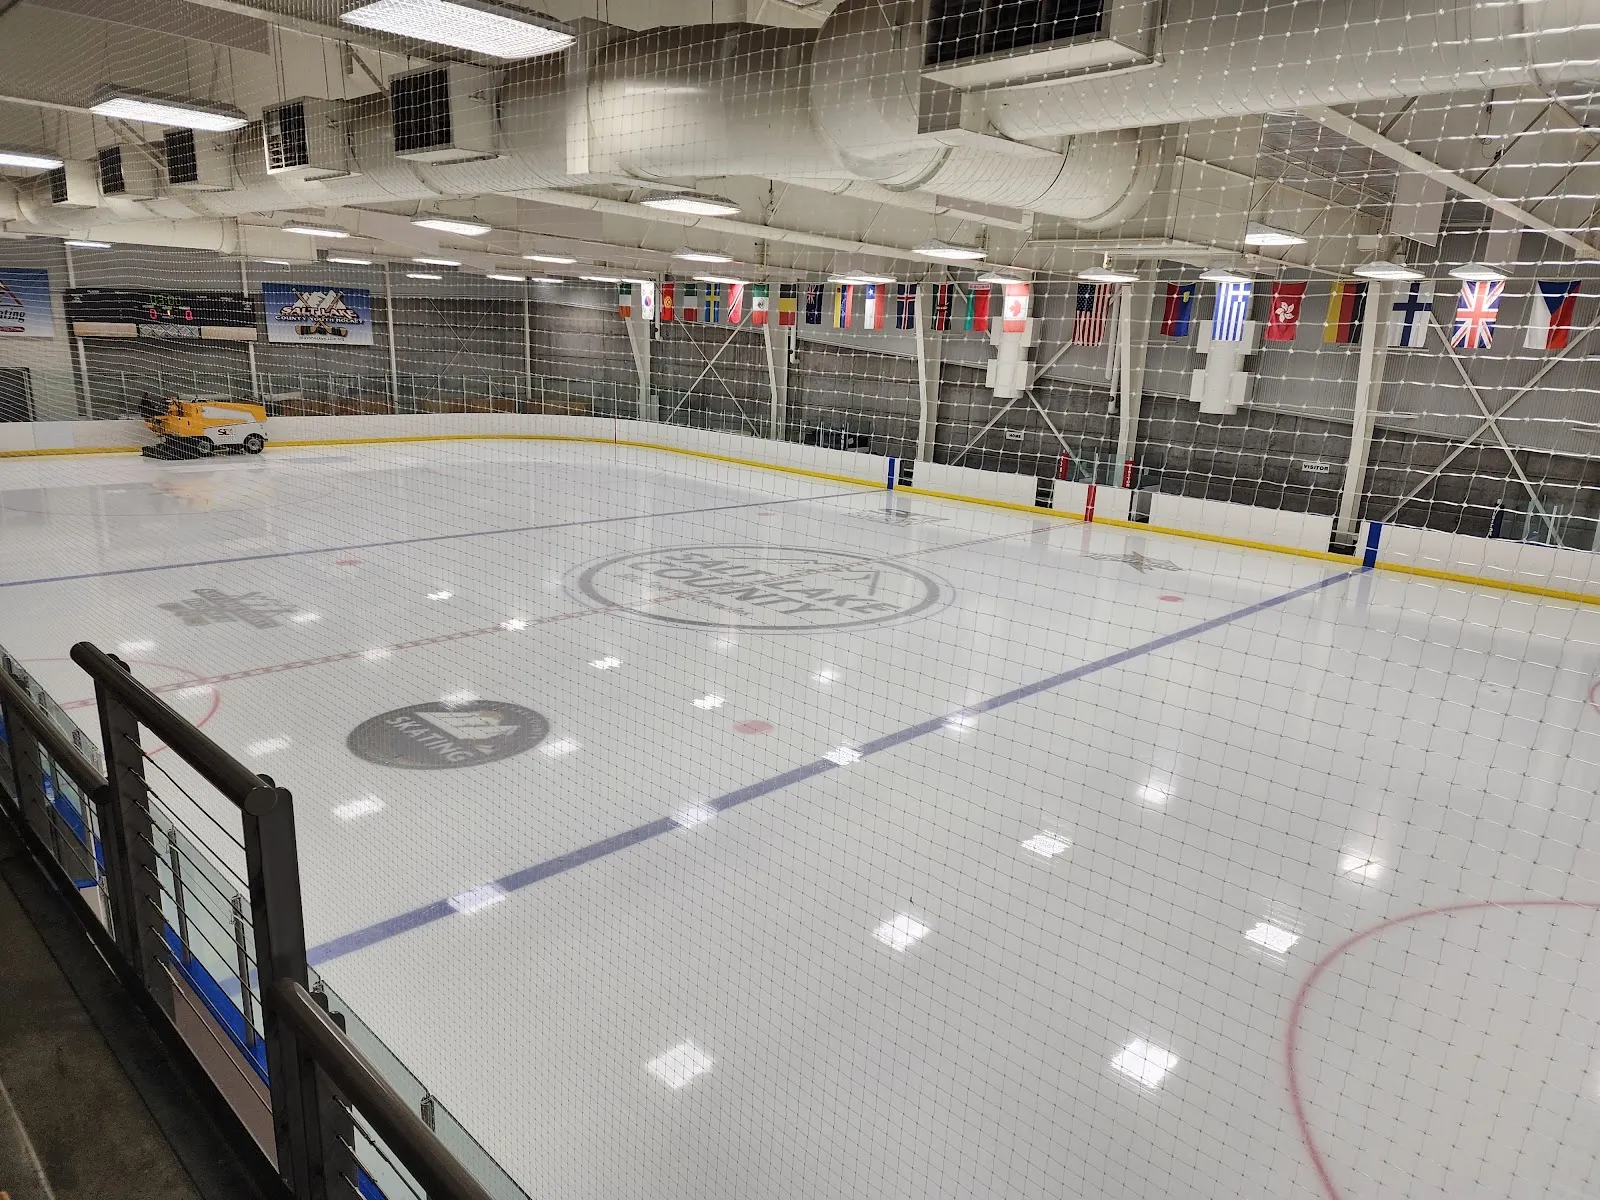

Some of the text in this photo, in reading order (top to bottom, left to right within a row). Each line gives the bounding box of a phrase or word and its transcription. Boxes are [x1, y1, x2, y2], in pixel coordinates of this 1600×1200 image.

[280, 306, 357, 320] SALT LAKE
[628, 561, 836, 614] COUNTY
[665, 553, 903, 614] SALT LAKE
[385, 716, 475, 762] SKATING
